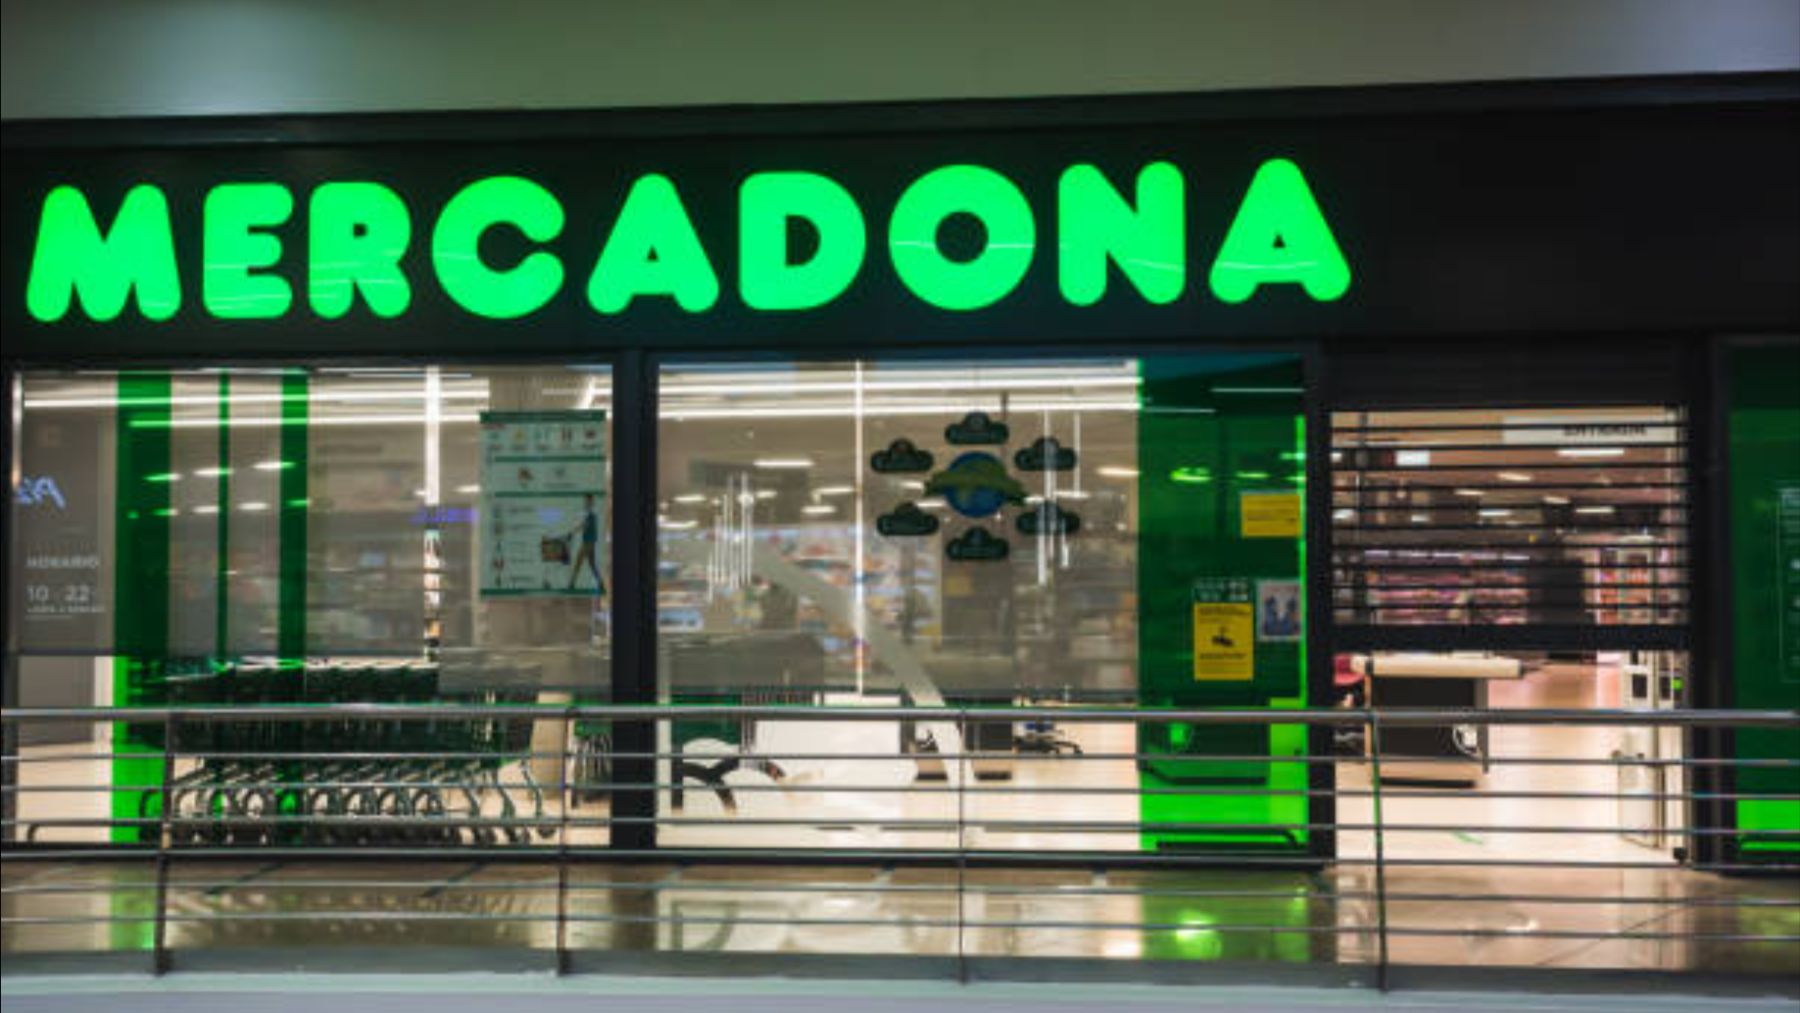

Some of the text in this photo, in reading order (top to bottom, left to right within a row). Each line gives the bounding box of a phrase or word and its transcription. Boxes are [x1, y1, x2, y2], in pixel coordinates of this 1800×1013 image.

[26, 158, 1351, 321] MERCADONA
[26, 584, 91, 602] 10 22
